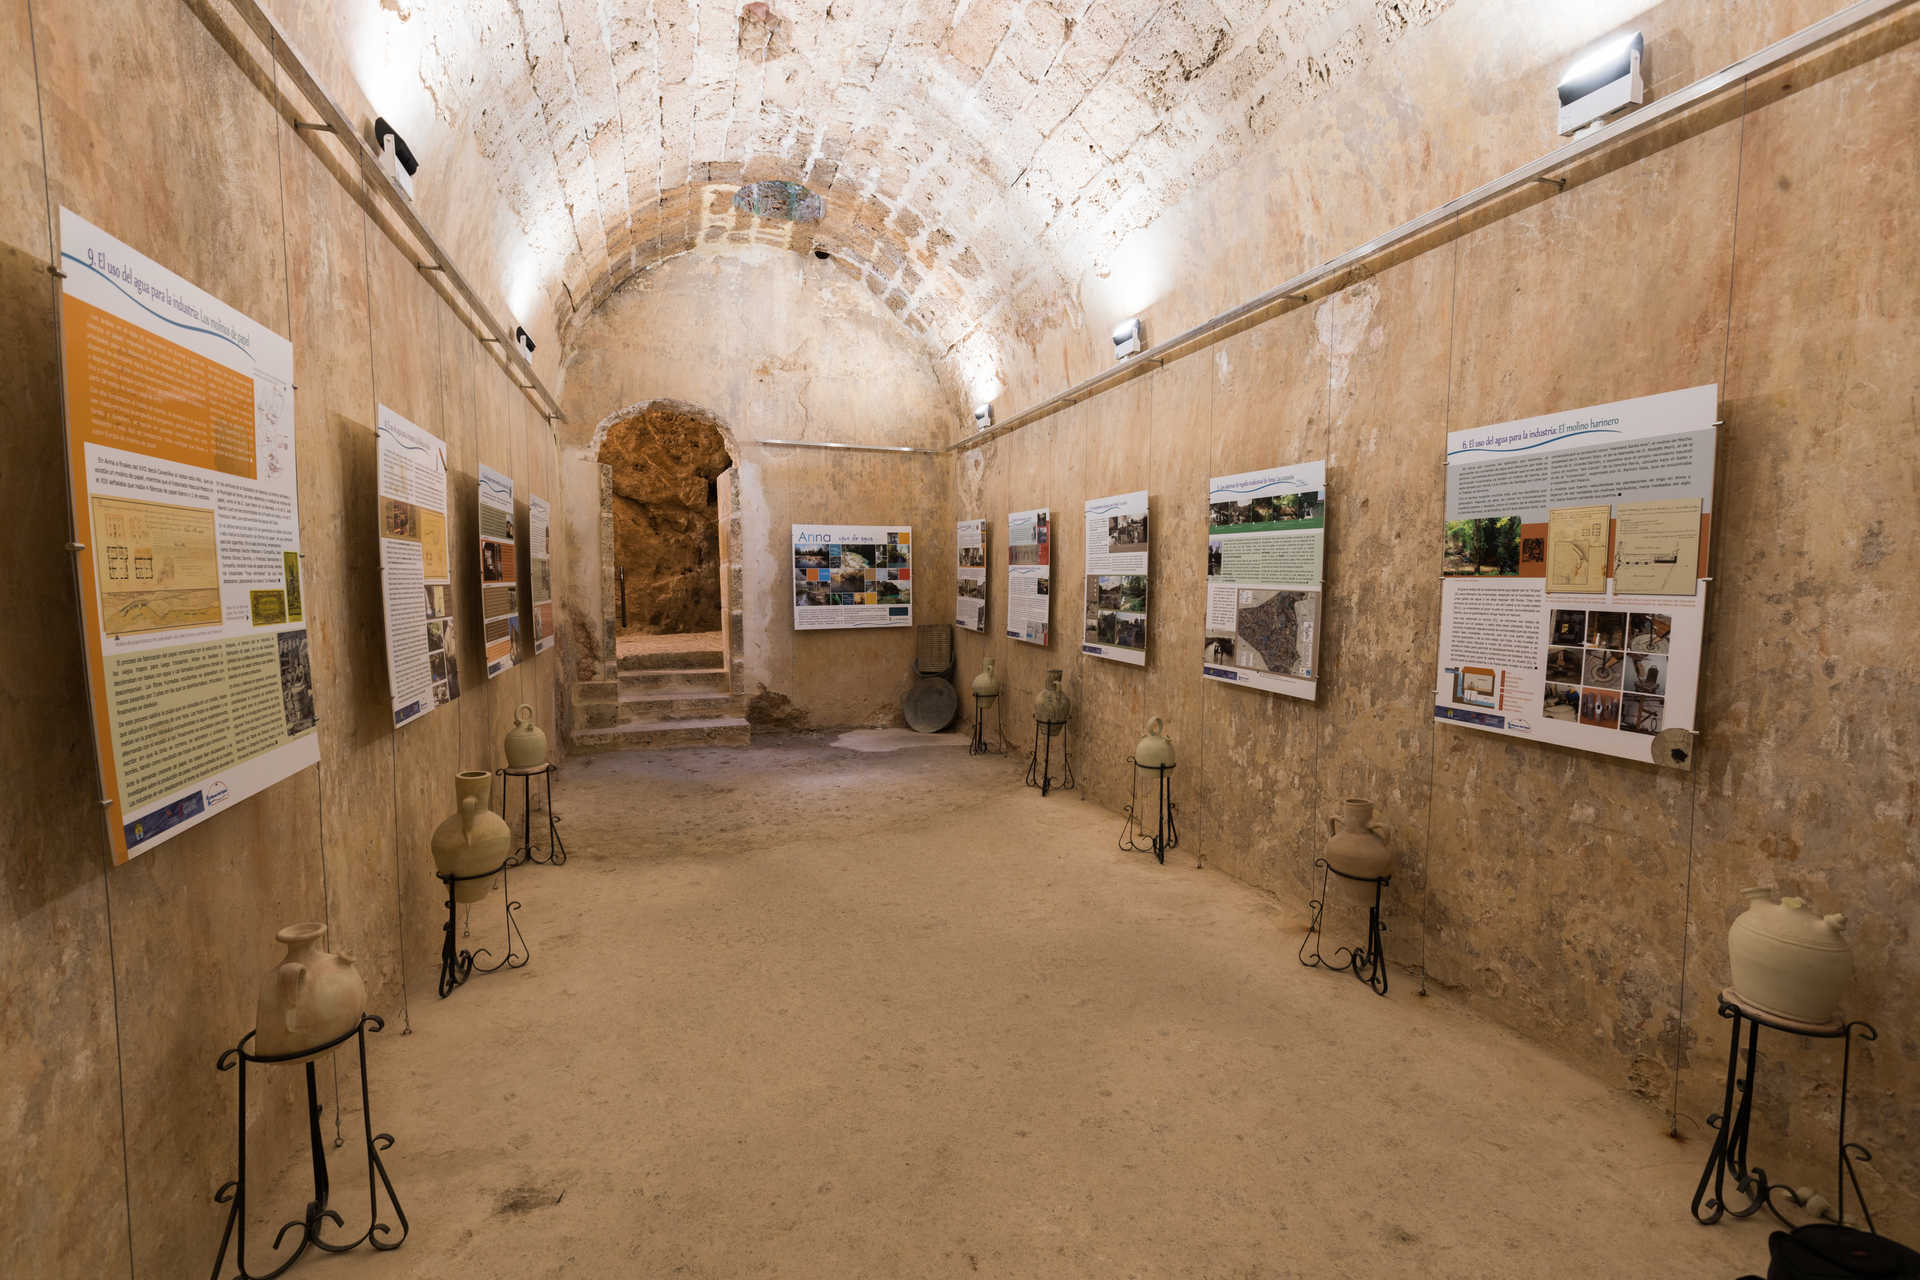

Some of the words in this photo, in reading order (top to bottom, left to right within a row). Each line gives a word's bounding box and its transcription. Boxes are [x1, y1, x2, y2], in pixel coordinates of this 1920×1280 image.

[87, 247, 97, 267] 9.
[98, 252, 105, 270] El
[107, 263, 121, 279] uso
[122, 264, 133, 285] del
[134, 276, 150, 296] agua
[151, 286, 166, 303] para
[166, 288, 172, 306] la
[1469, 438, 1475, 448] El
[1486, 435, 1494, 446] del
[1495, 436, 1508, 448] agua
[1509, 434, 1522, 446] para
[1523, 430, 1529, 439] la
[1558, 425, 1565, 434] El
[1566, 420, 1589, 432] molino
[1590, 418, 1620, 429] harinero
[799, 531, 831, 542] Anna
